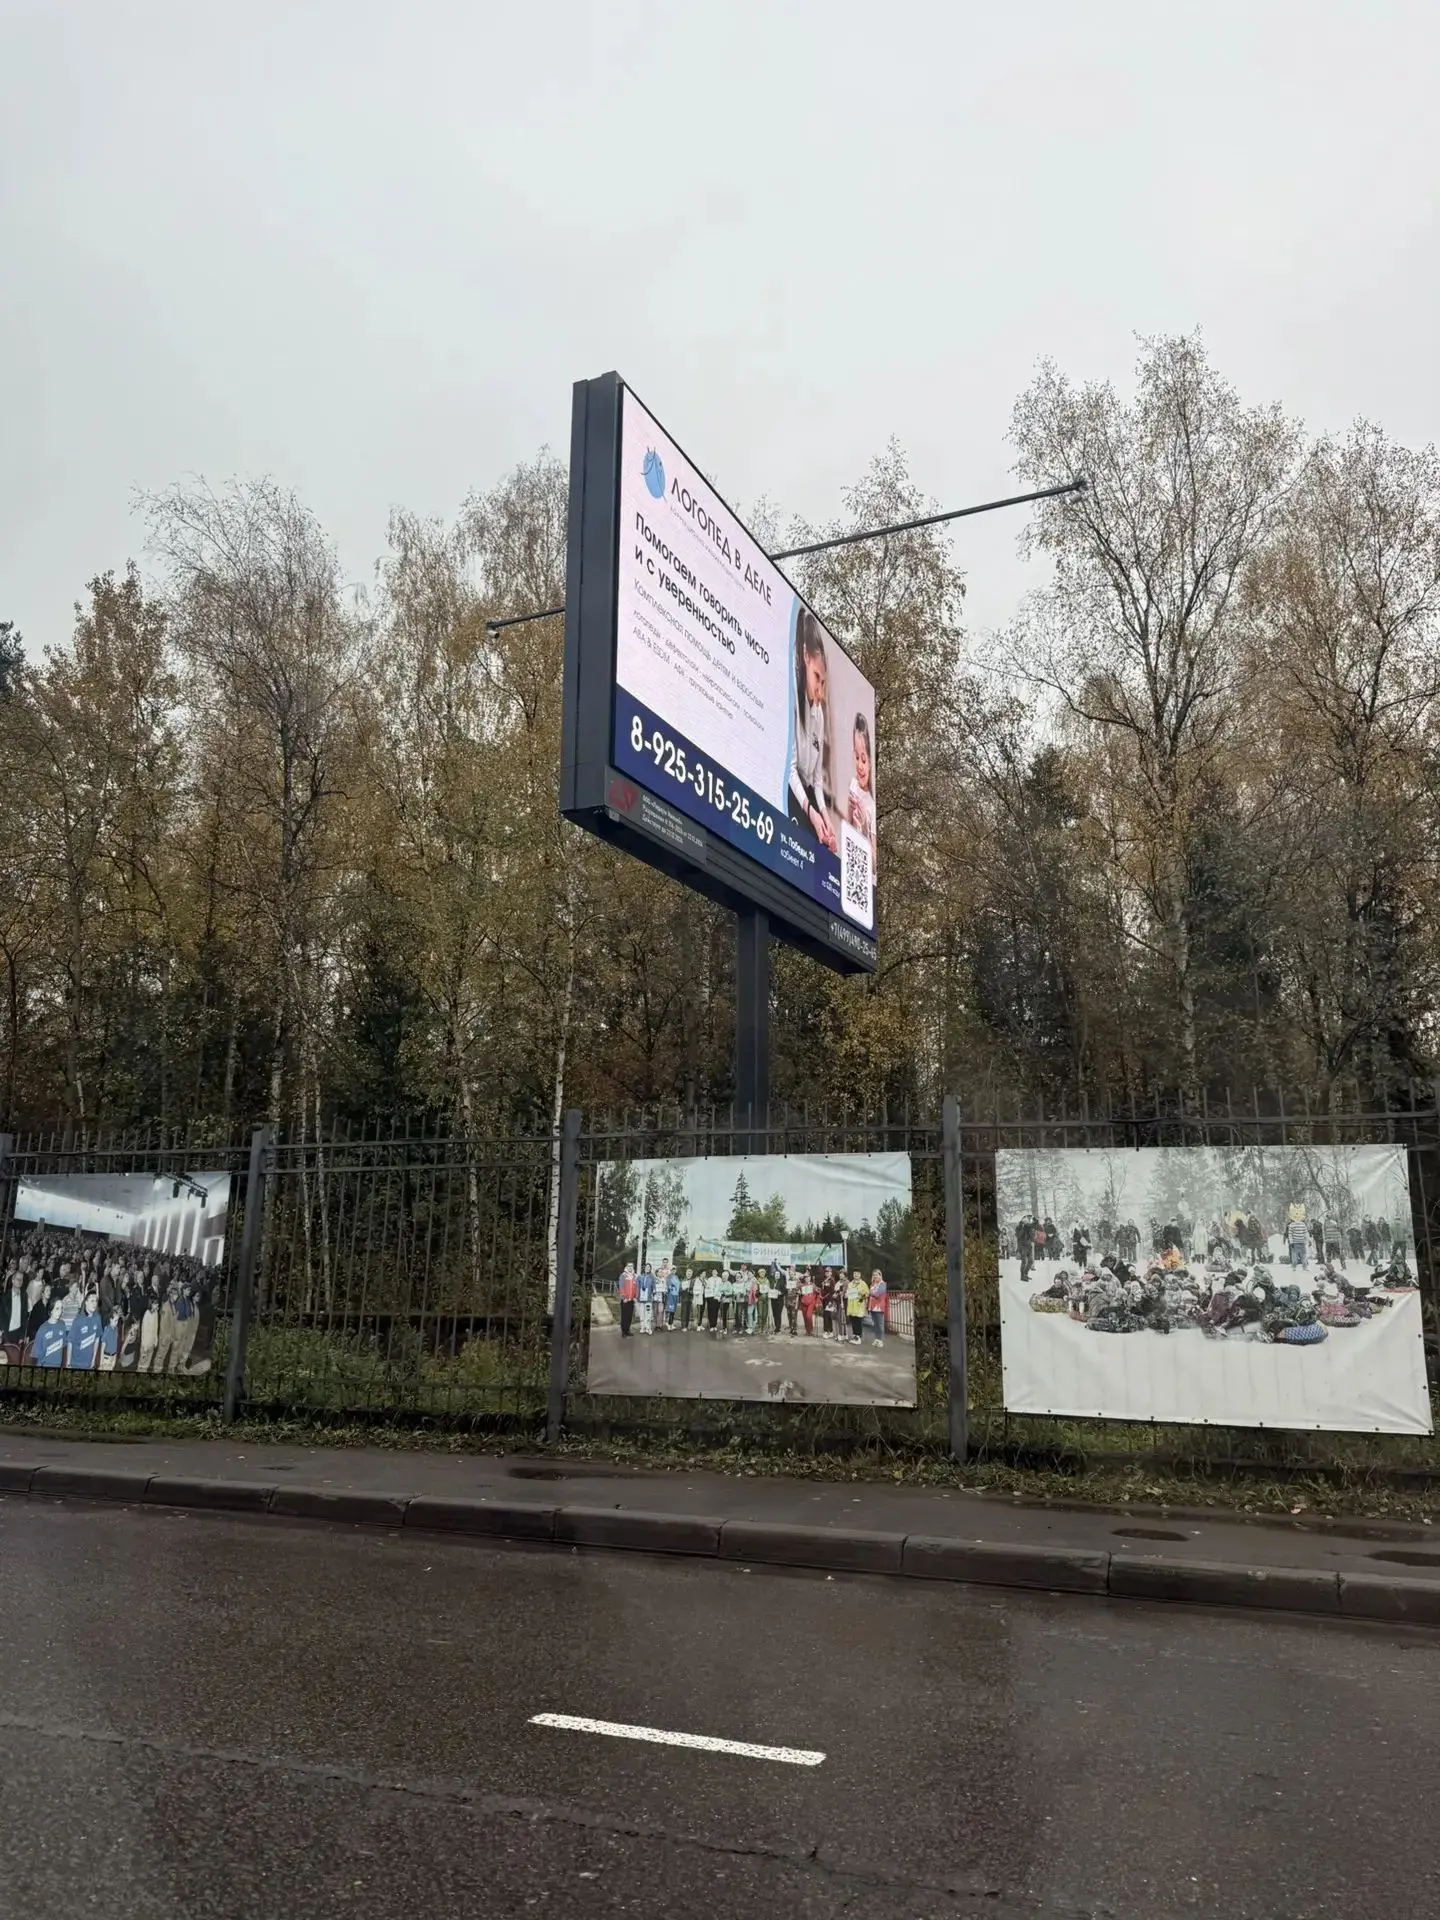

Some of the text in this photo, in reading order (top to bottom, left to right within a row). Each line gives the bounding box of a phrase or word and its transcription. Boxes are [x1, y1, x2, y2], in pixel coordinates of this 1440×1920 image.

[635, 545, 735, 655] и с уверенностью
[636, 512, 697, 590] Помогаем
[700, 582, 742, 636] говорить
[745, 630, 770, 665] чисто
[671, 478, 772, 606] ЛОГОПЕД В ДЕЛЕ
[631, 715, 774, 845] 8-925-315-25-69
